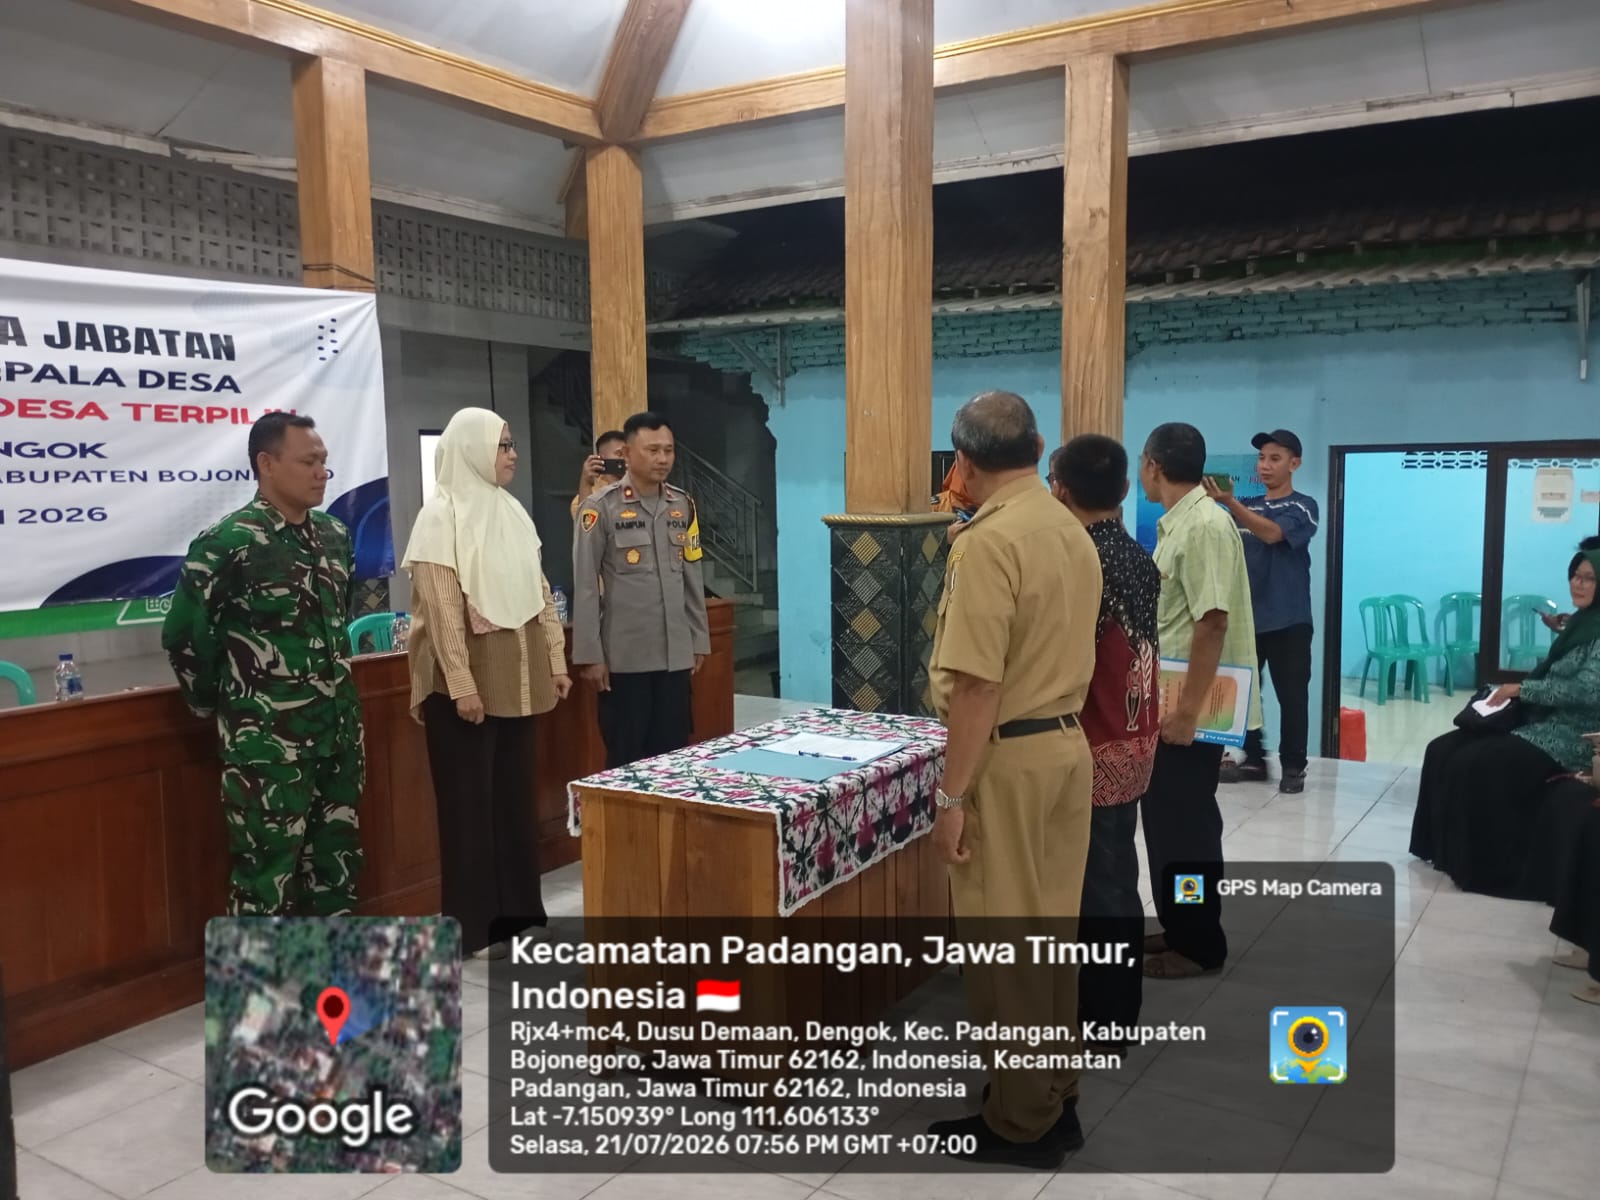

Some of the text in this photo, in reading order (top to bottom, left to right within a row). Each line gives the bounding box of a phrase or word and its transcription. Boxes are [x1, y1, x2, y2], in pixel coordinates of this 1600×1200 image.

[43, 320, 236, 361] JABATAN
[0, 361, 241, 393] PALA DESA
[121, 403, 297, 425] TERPIL
[0, 469, 334, 484] BUPATEN BOJONO
[17, 507, 108, 524] 2026
